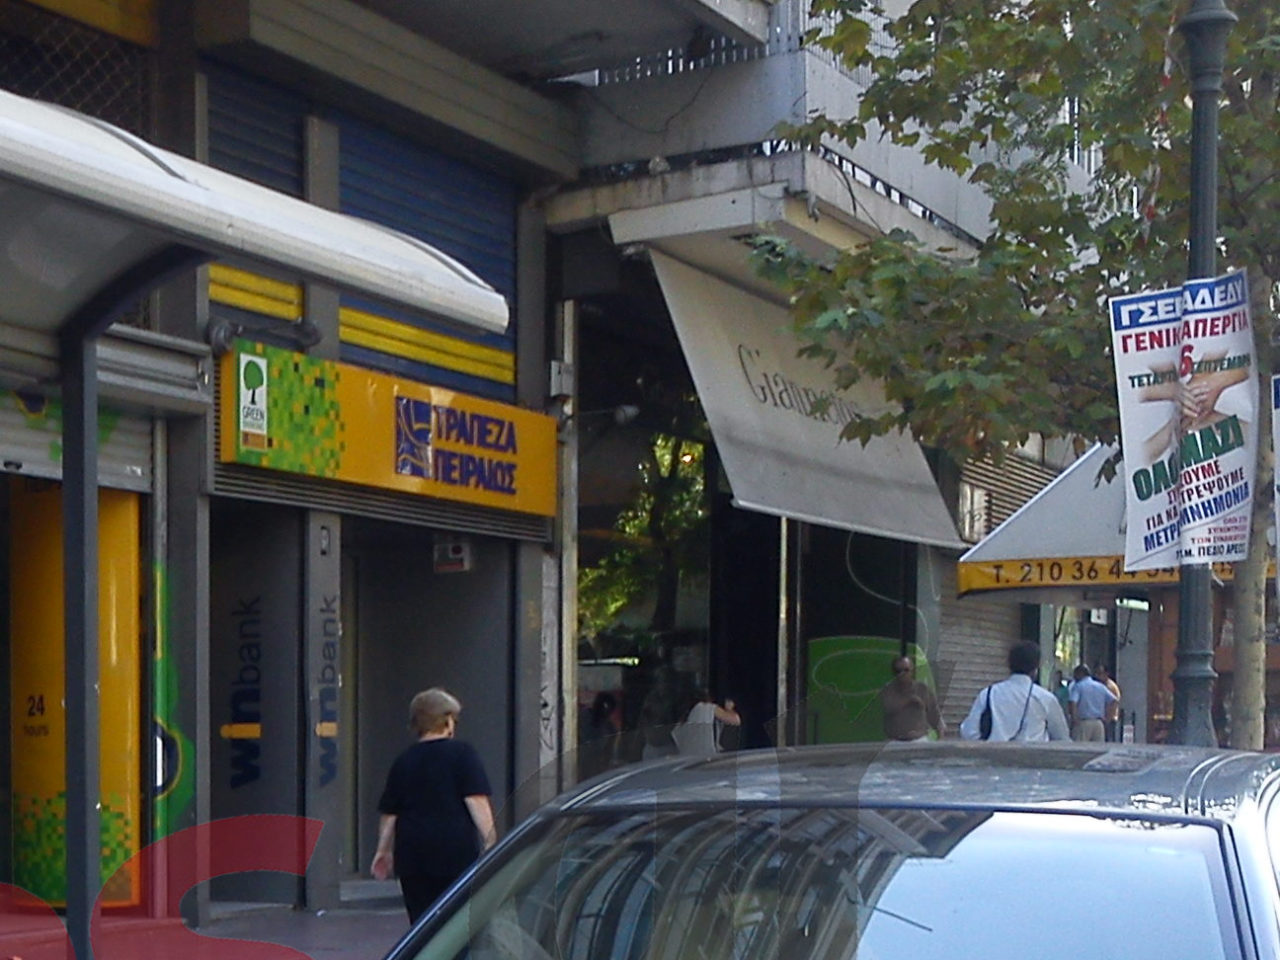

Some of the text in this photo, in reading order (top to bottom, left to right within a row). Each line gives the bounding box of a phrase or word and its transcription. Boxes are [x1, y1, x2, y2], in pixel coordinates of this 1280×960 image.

[1181, 309, 1249, 341] ΑΠΕΡΓΙΑ
[1179, 344, 1194, 377] 6
[432, 404, 517, 455] ΤΡΑΠΕΖΑ
[433, 447, 517, 495] ΠΕΙΡΑΙΩΣ
[1019, 557, 1063, 583] 210
[1071, 558, 1099, 581] 36
[27, 695, 45, 717] 24
